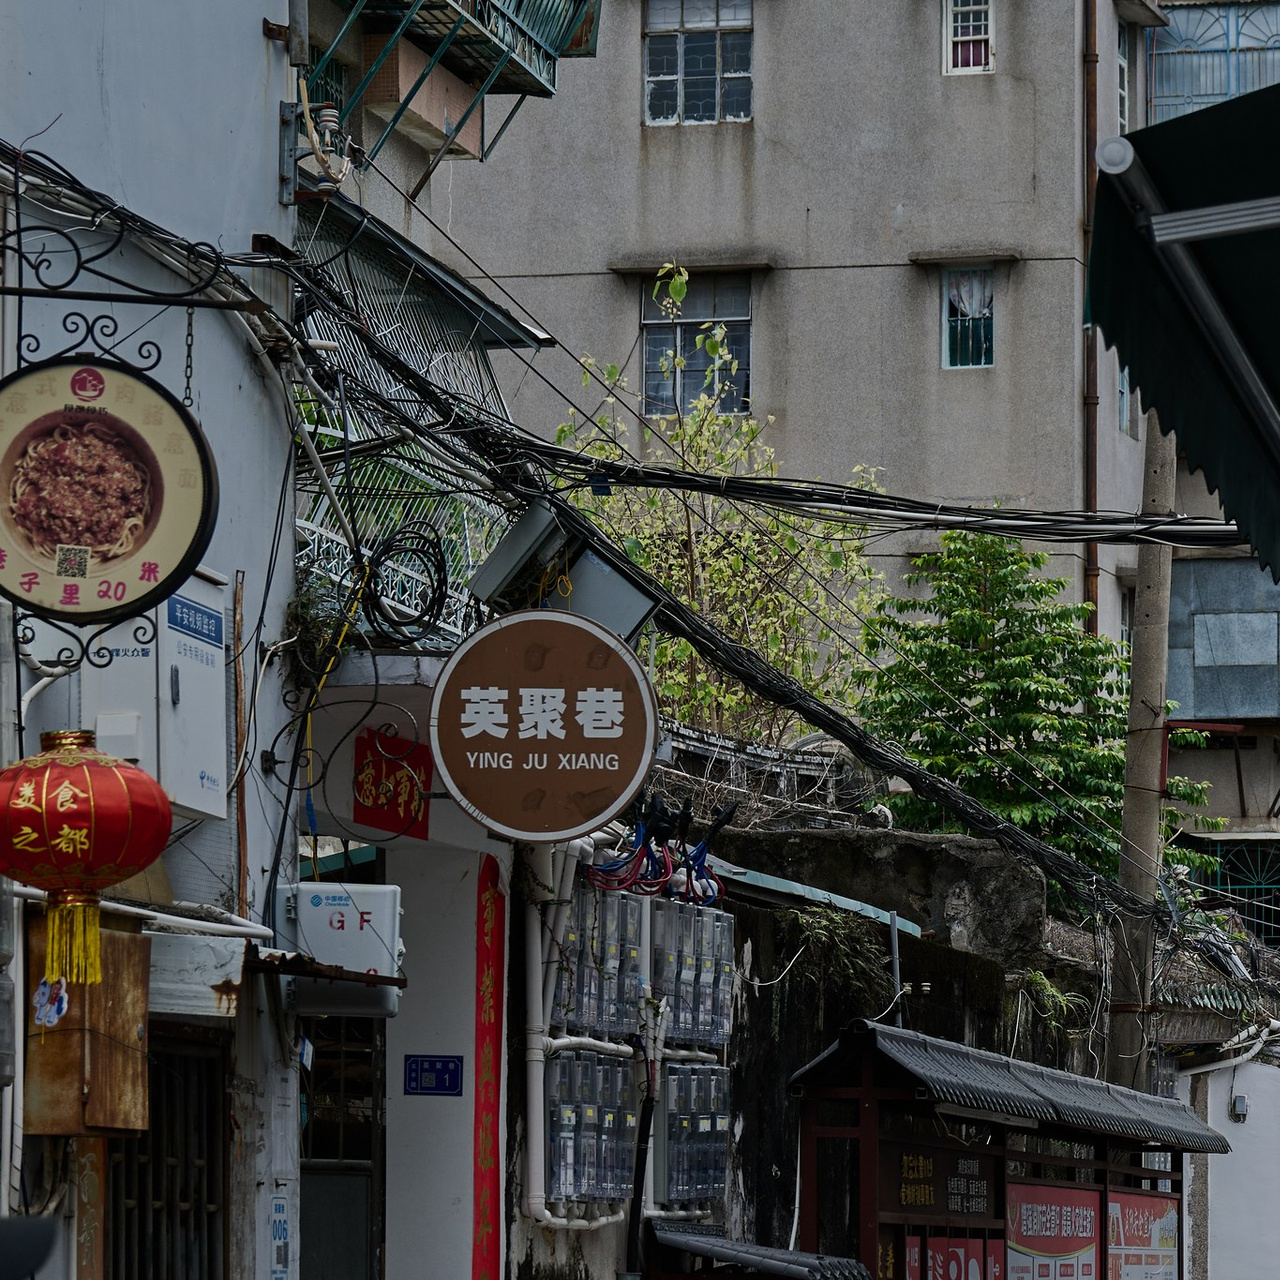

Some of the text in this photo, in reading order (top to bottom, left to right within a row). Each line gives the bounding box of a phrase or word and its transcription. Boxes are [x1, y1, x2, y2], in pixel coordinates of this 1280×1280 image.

[460, 686, 626, 740] 英聚巷
[466, 751, 620, 771] YING JU XIANG
[10, 778, 89, 813] 美食
[12, 824, 90, 860] 之都
[272, 1219, 288, 1240] 006
